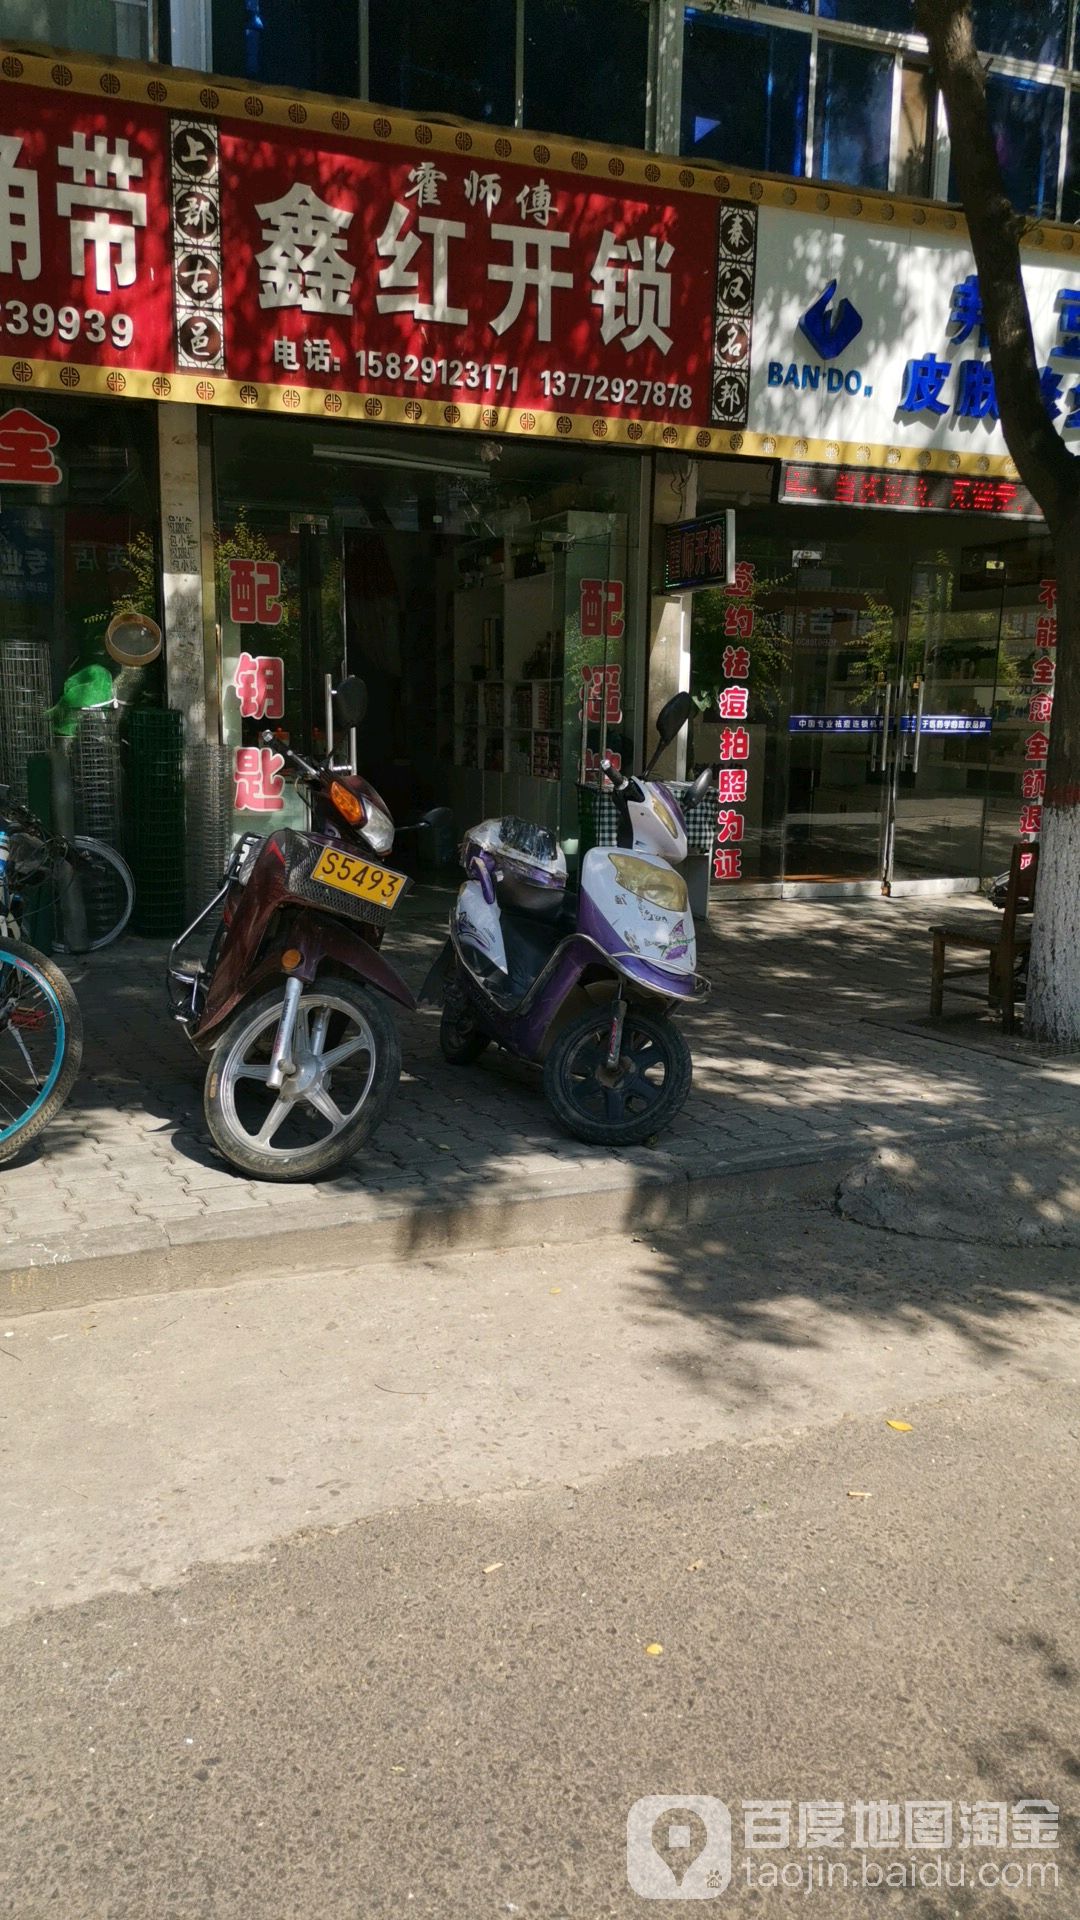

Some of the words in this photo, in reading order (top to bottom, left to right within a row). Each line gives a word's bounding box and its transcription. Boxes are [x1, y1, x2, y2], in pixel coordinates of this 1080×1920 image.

[0, 300, 133, 348] 39939
[254, 182, 676, 356] 鑫红开锁
[355, 349, 519, 392] 15829123171
[540, 369, 693, 409] 13772927878
[228, 559, 285, 813] 配钥匙
[713, 561, 755, 880] 签约祛痘拍照为证
[322, 852, 400, 898] S5493
